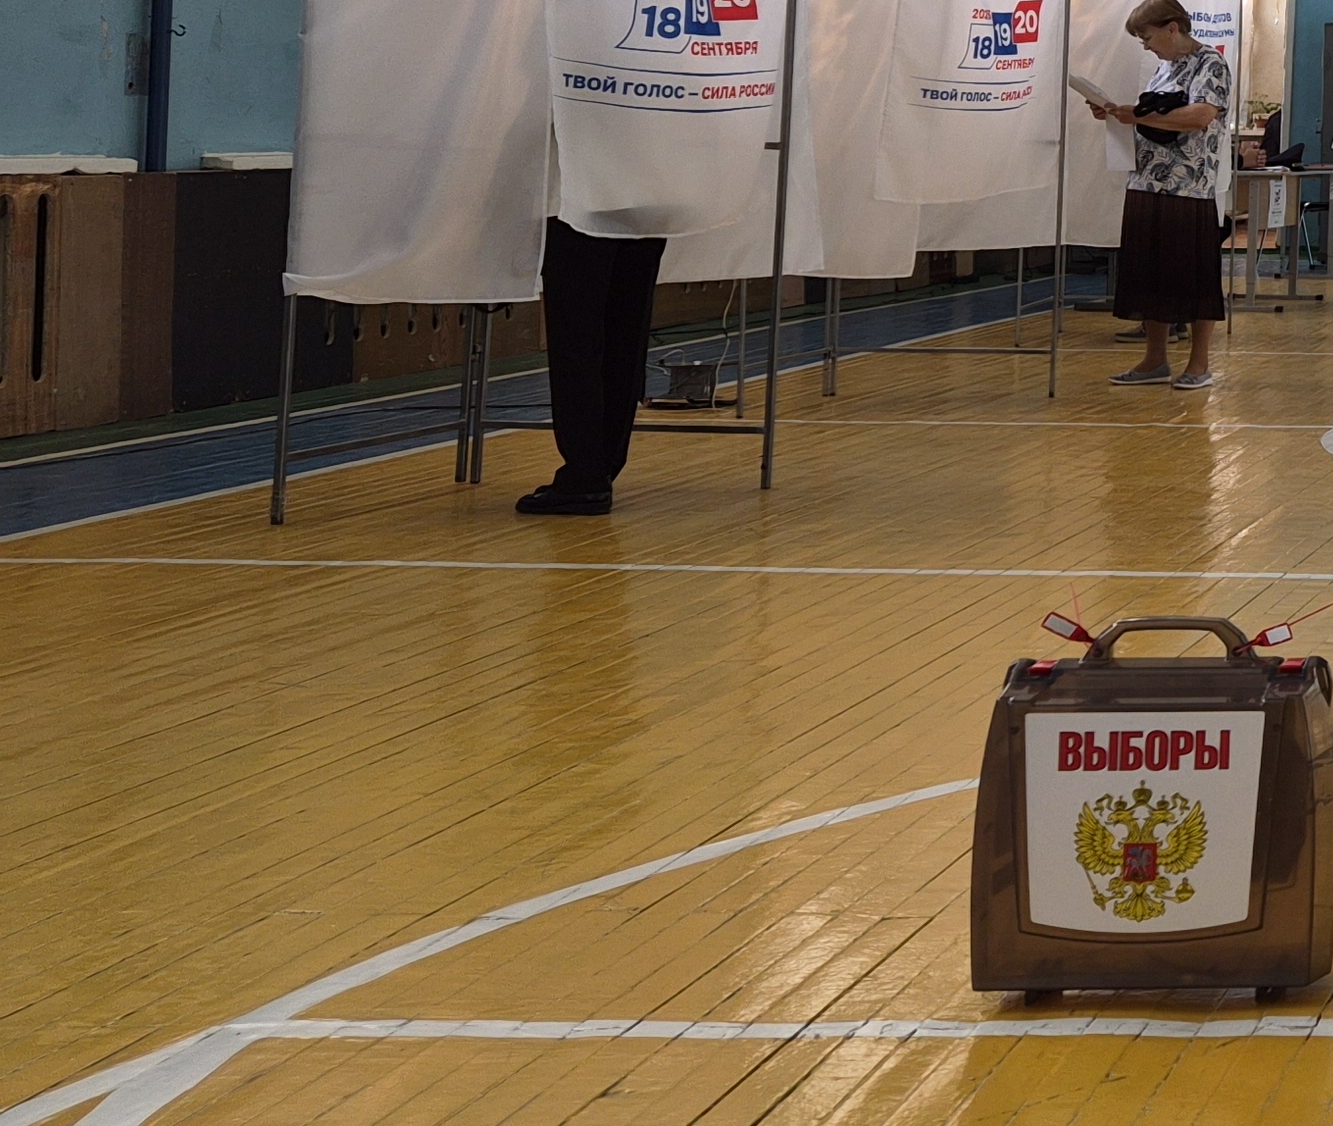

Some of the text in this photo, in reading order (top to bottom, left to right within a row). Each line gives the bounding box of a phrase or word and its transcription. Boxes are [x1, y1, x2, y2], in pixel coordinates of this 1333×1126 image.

[641, 5, 682, 39] 18
[971, 9, 1038, 60] 18 19 20
[690, 41, 759, 56] СЕНТЯБРЯ
[995, 57, 1035, 70] СЕНТЯБР
[562, 73, 617, 94] ТВОЙ
[622, 82, 686, 99] ГОЛОС
[701, 86, 736, 100] СИЛА
[920, 88, 958, 102] ТВОЙ
[960, 91, 993, 102] ГОЛОС
[1058, 730, 1231, 772] ВЫБОРЫ
